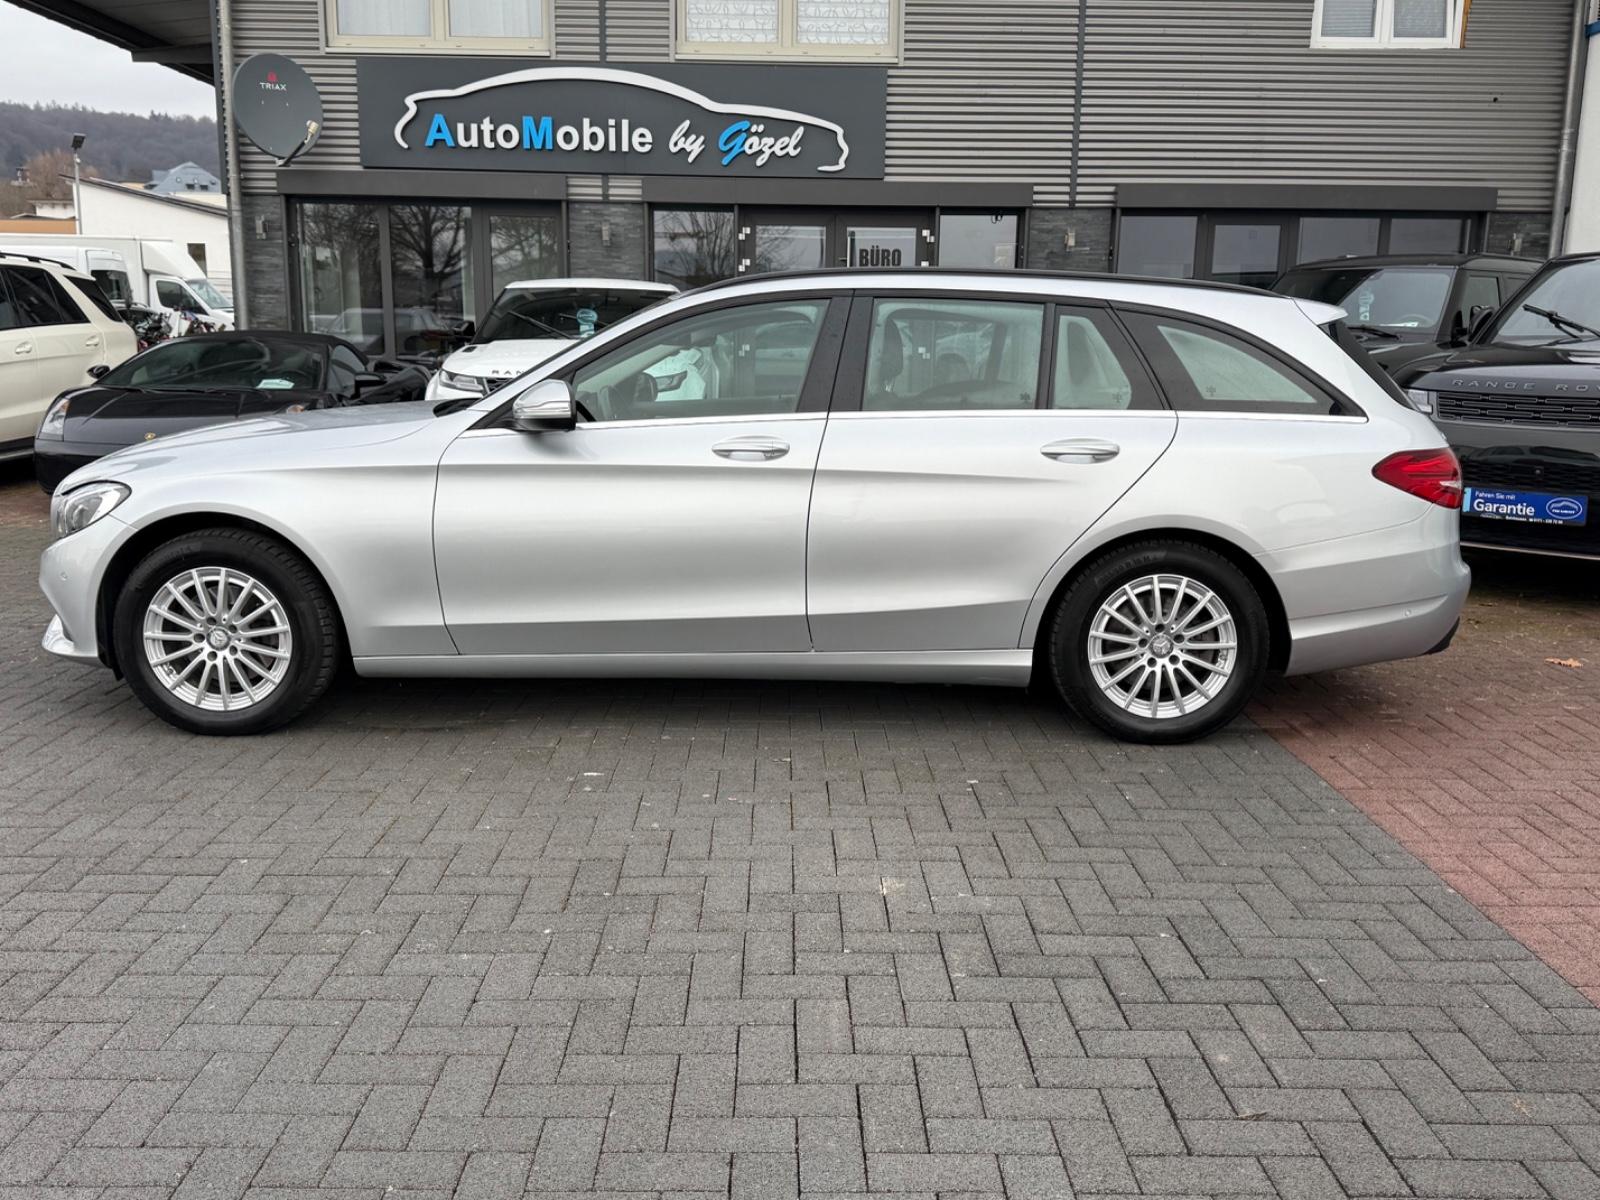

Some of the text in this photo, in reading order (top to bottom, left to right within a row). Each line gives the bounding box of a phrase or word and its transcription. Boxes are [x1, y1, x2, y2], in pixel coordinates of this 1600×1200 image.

[260, 82, 287, 91] TRIAX
[425, 113, 804, 167] AutoMobile by Gözel
[859, 245, 902, 267] BÜRO
[1452, 379, 1536, 390] RANGE
[1473, 498, 1535, 516] Garantie
